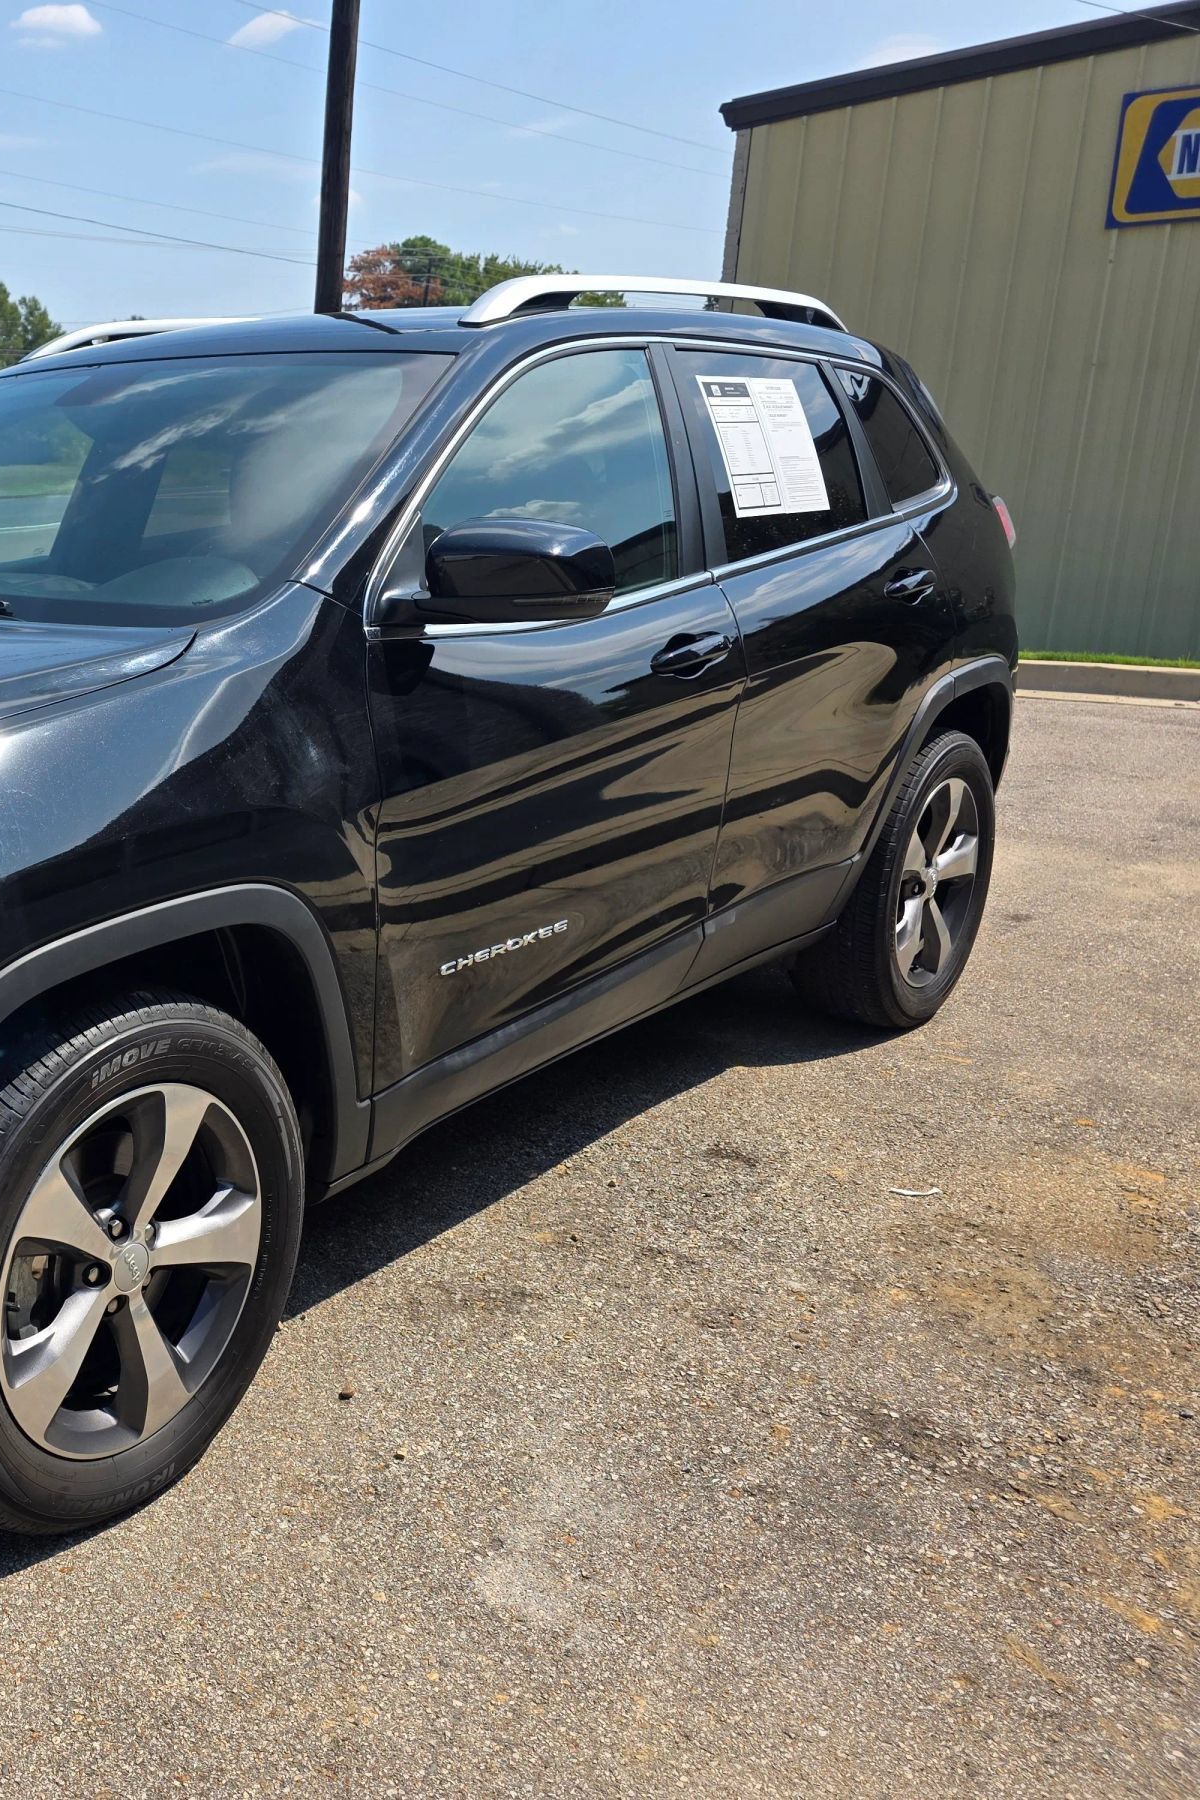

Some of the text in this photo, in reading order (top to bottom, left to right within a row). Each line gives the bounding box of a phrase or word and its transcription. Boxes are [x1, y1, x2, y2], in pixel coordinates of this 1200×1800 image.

[1176, 132, 1200, 174] N
[439, 918, 569, 976] CHEROKEE
[124, 1252, 141, 1281] Jeep
